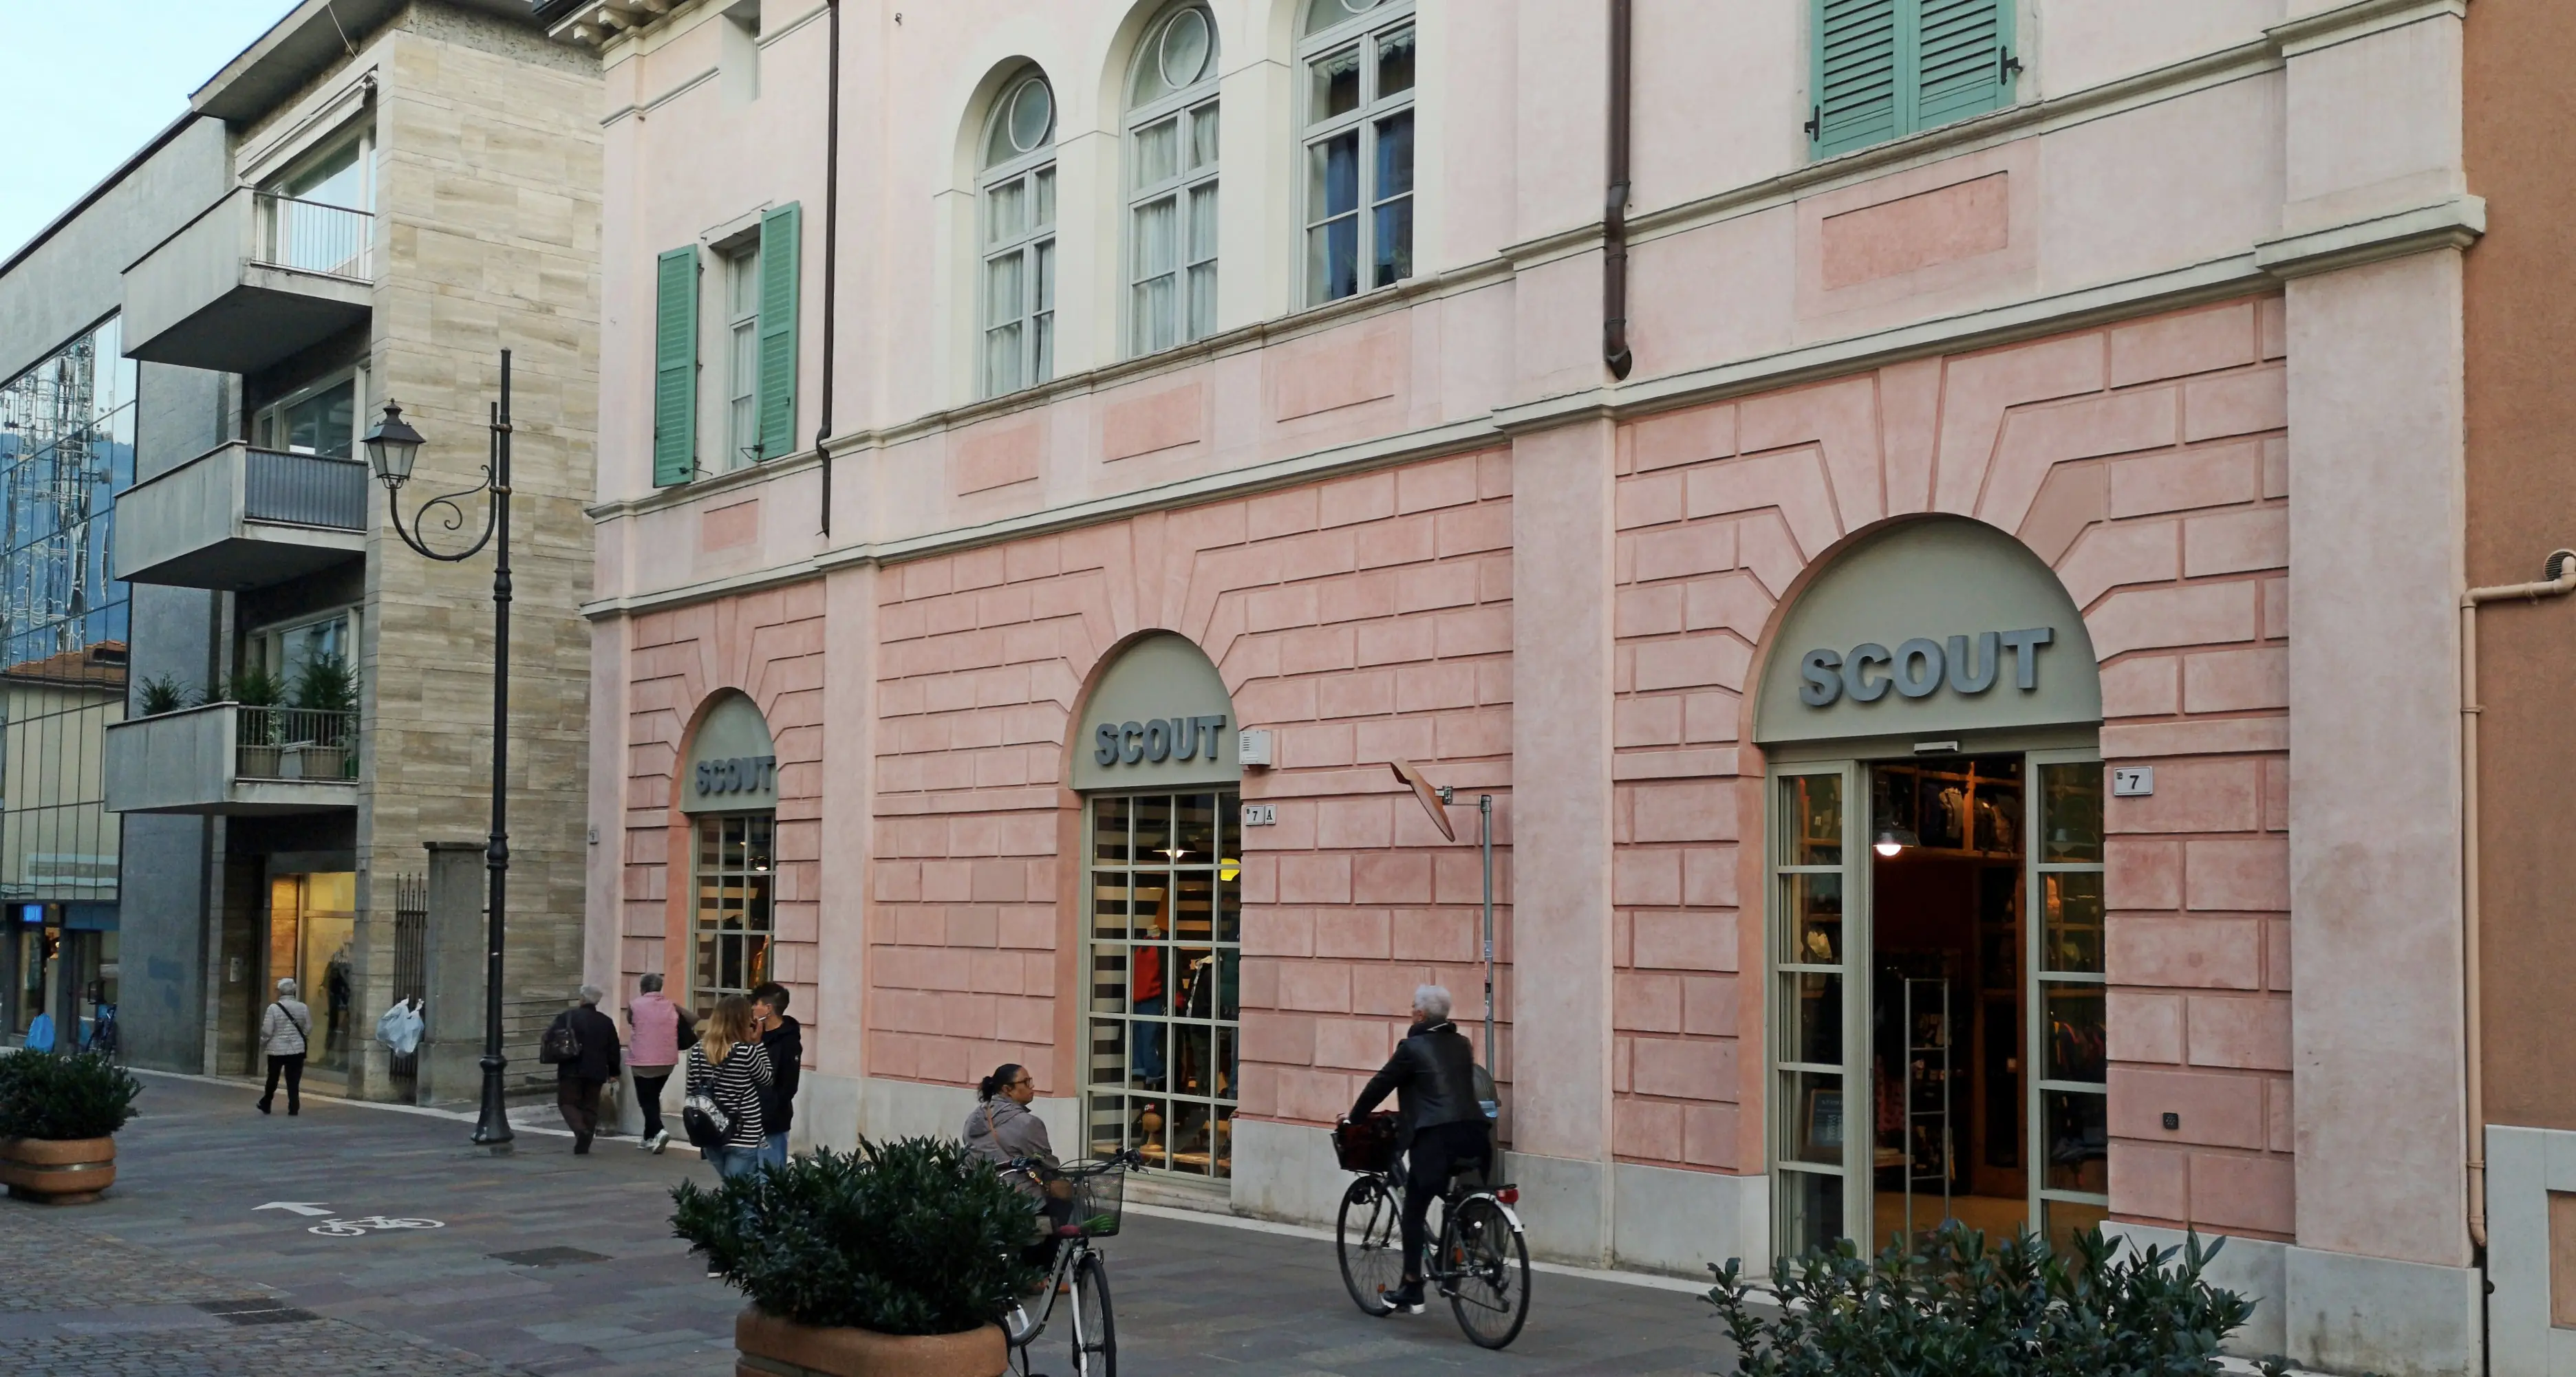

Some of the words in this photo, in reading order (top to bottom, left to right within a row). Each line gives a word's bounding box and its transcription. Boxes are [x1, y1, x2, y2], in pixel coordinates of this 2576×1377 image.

[1799, 627, 2054, 706] SCOUT
[1094, 715, 1226, 766] SCOUT
[695, 756, 776, 795] SCOUT
[2129, 774, 2140, 790] 7
[1252, 810, 1258, 821] 7
[1266, 809, 1273, 821] A
